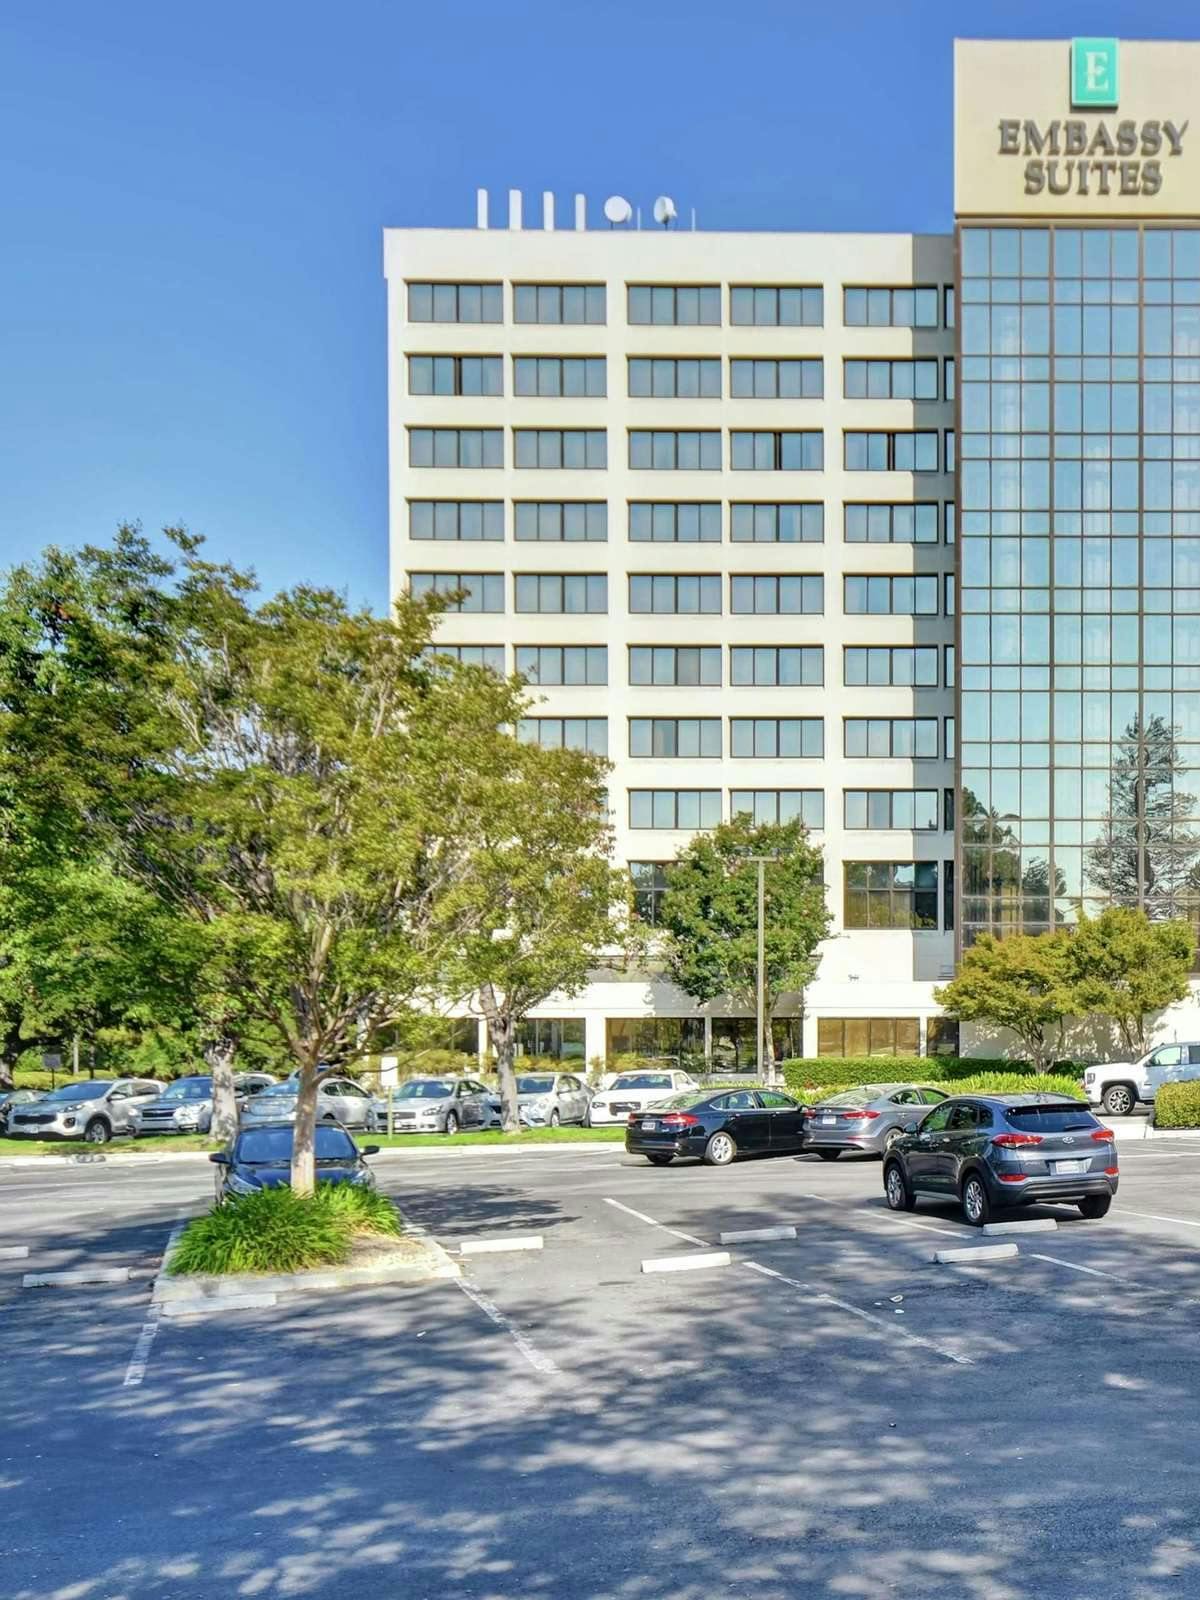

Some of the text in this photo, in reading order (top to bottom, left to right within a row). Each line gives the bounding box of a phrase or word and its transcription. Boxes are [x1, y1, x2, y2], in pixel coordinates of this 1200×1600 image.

[1085, 51, 1109, 92] E
[998, 119, 1189, 156] EMBASSY
[1024, 159, 1163, 196] SUITES
